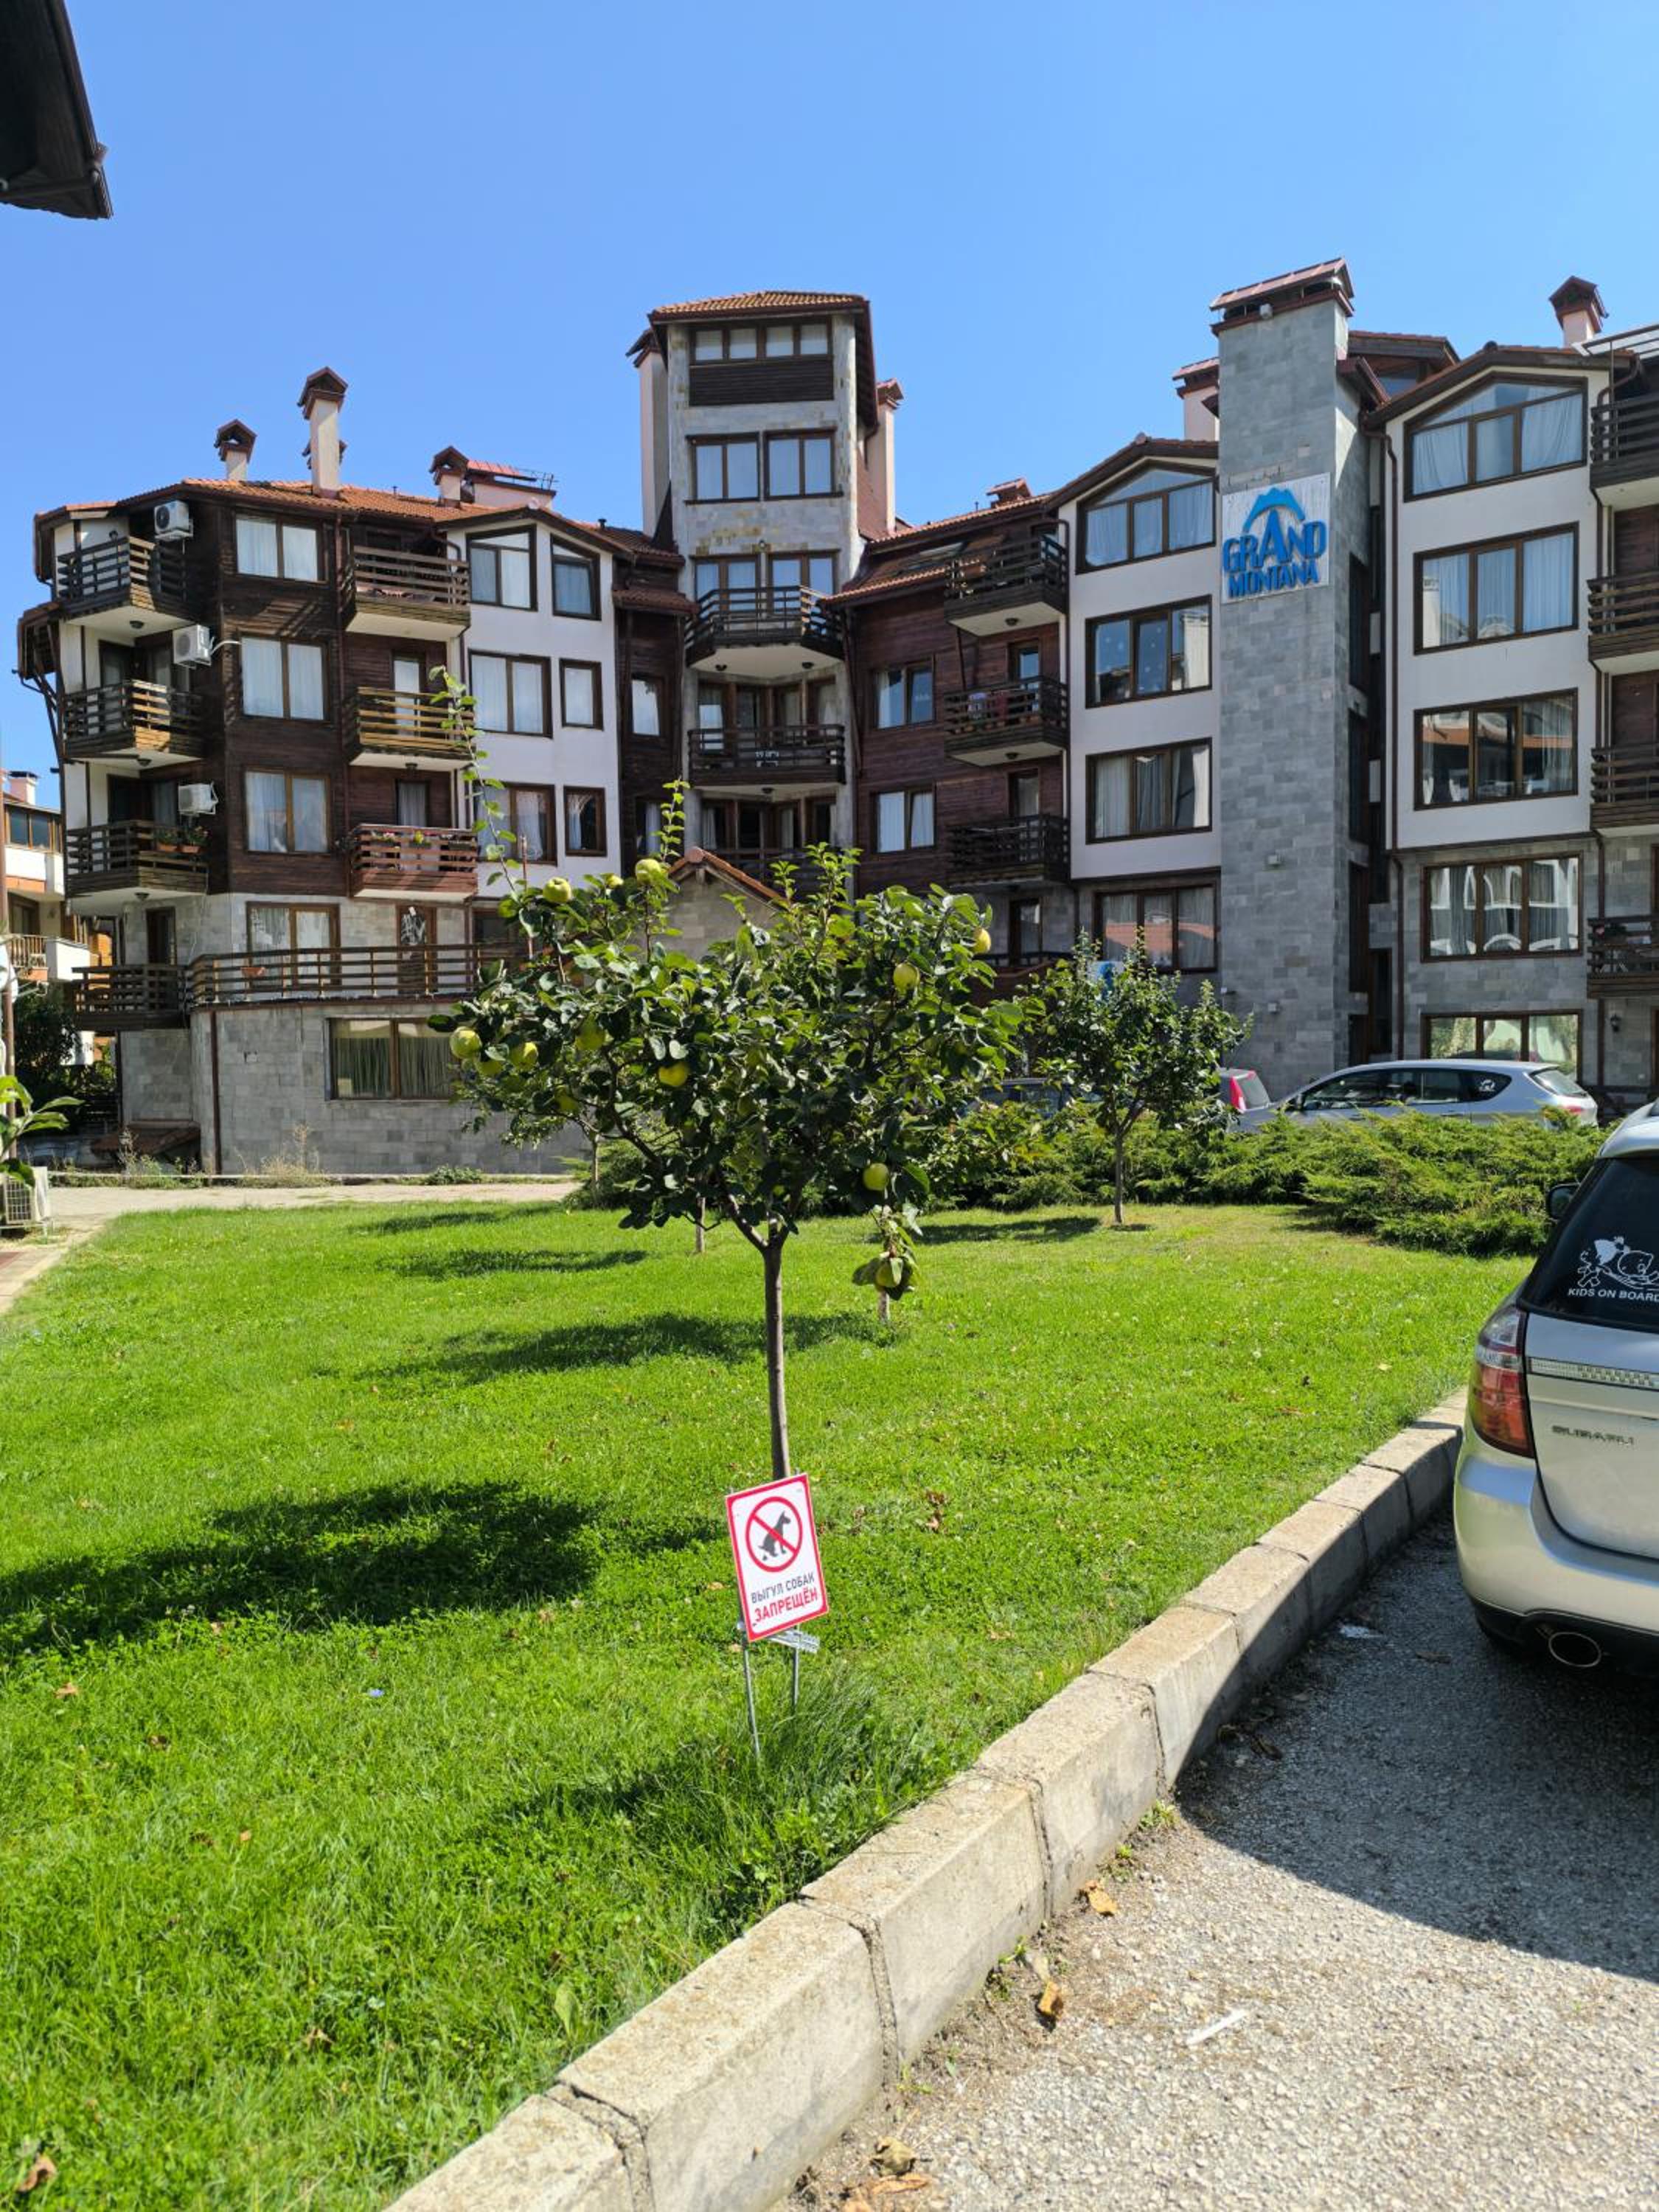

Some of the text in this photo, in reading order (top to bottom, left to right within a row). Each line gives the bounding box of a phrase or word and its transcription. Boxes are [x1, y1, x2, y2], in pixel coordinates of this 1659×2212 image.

[1223, 508, 1326, 573] GRAND
[1228, 560, 1320, 598] MONTANA
[1568, 1288, 1595, 1297] KIDS
[1598, 1288, 1617, 1298] ON
[751, 1571, 815, 1604] ВЫГУЛ СОБАК
[754, 1586, 818, 1622] ЗАПРЕЩЁН
